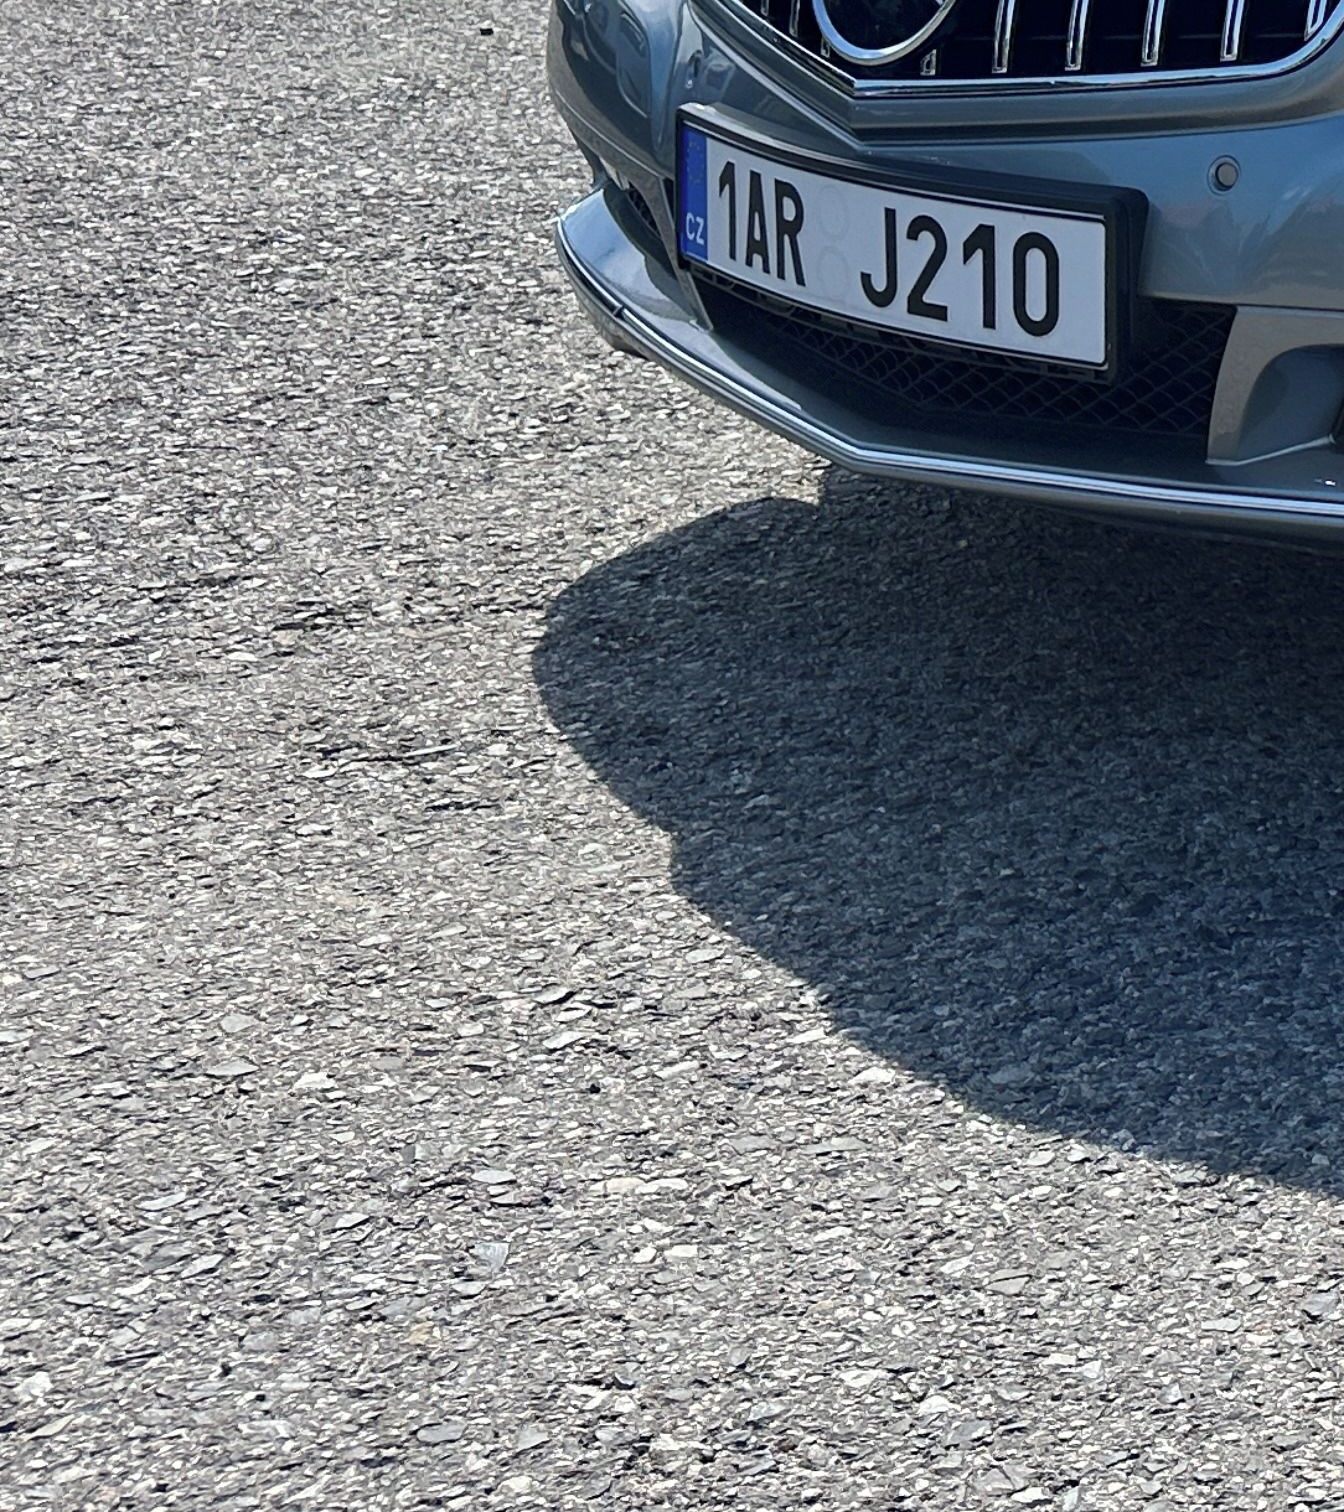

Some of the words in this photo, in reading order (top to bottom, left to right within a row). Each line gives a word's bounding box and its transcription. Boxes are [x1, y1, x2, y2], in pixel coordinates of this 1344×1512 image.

[686, 212, 705, 245] CZ
[719, 160, 806, 288] 1AR
[860, 206, 1060, 337] J210
